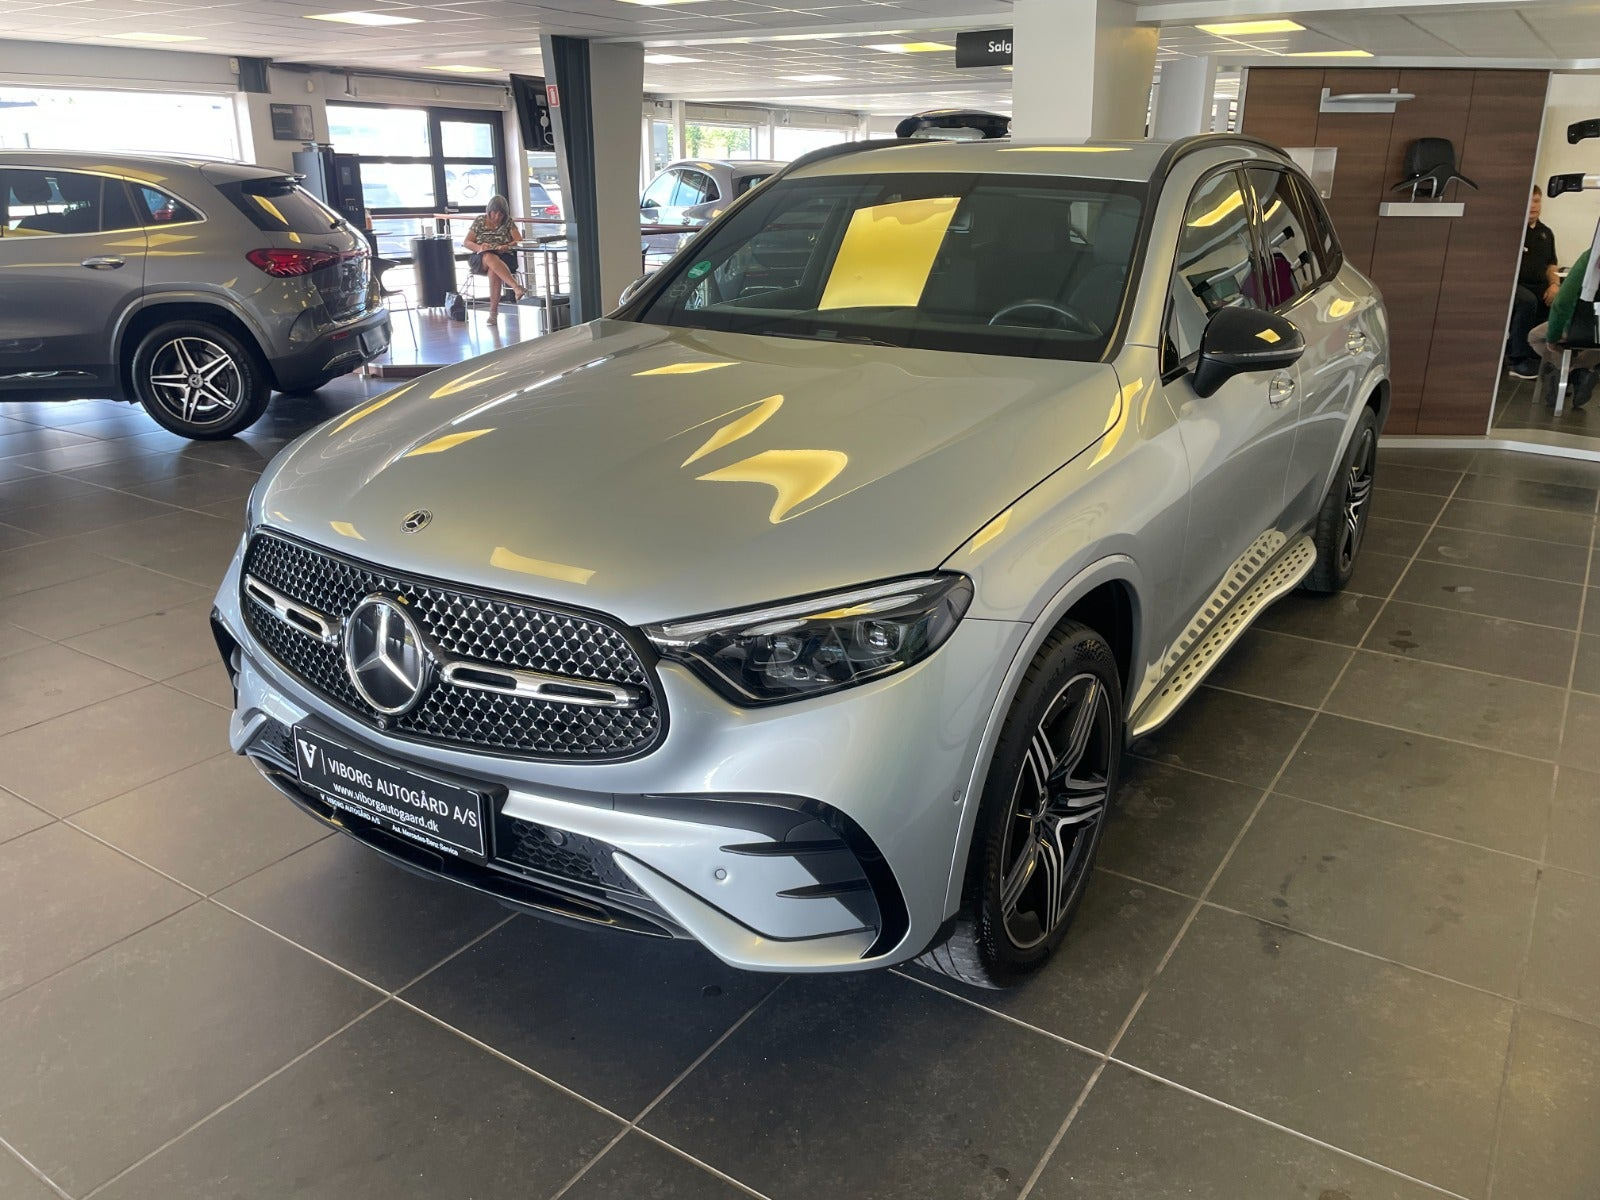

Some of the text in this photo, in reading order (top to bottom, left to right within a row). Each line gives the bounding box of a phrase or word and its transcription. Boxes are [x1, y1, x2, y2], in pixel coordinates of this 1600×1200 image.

[988, 40, 1012, 54] Salg
[327, 757, 478, 828] VIBORG AUTOGÅRD A/S
[333, 782, 440, 833] www.viborgautogaard.dk
